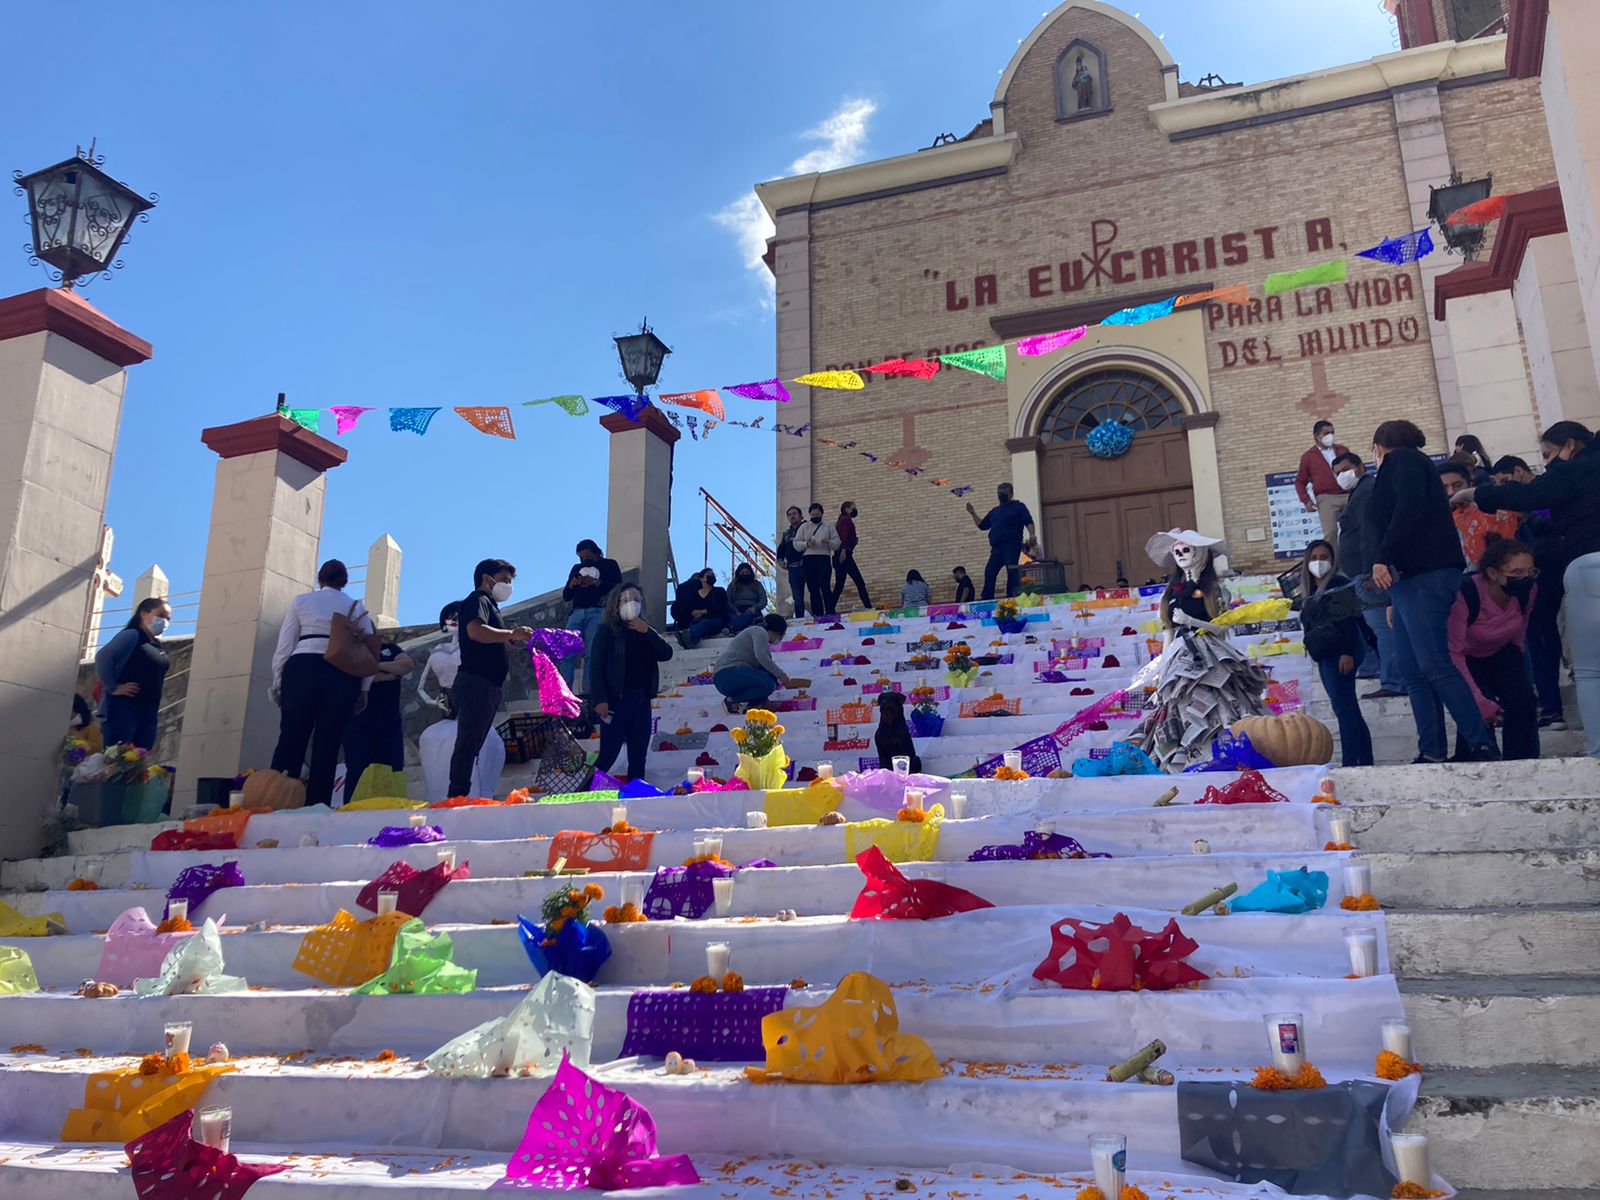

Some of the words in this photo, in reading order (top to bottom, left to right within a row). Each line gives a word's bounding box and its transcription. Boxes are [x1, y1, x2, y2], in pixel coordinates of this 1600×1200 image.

[1207, 294, 1283, 330] PARA
[1295, 286, 1333, 317] LA
[1345, 273, 1414, 310] VIDA
[1218, 335, 1282, 367] DEL
[1298, 316, 1419, 358] MUNDO
